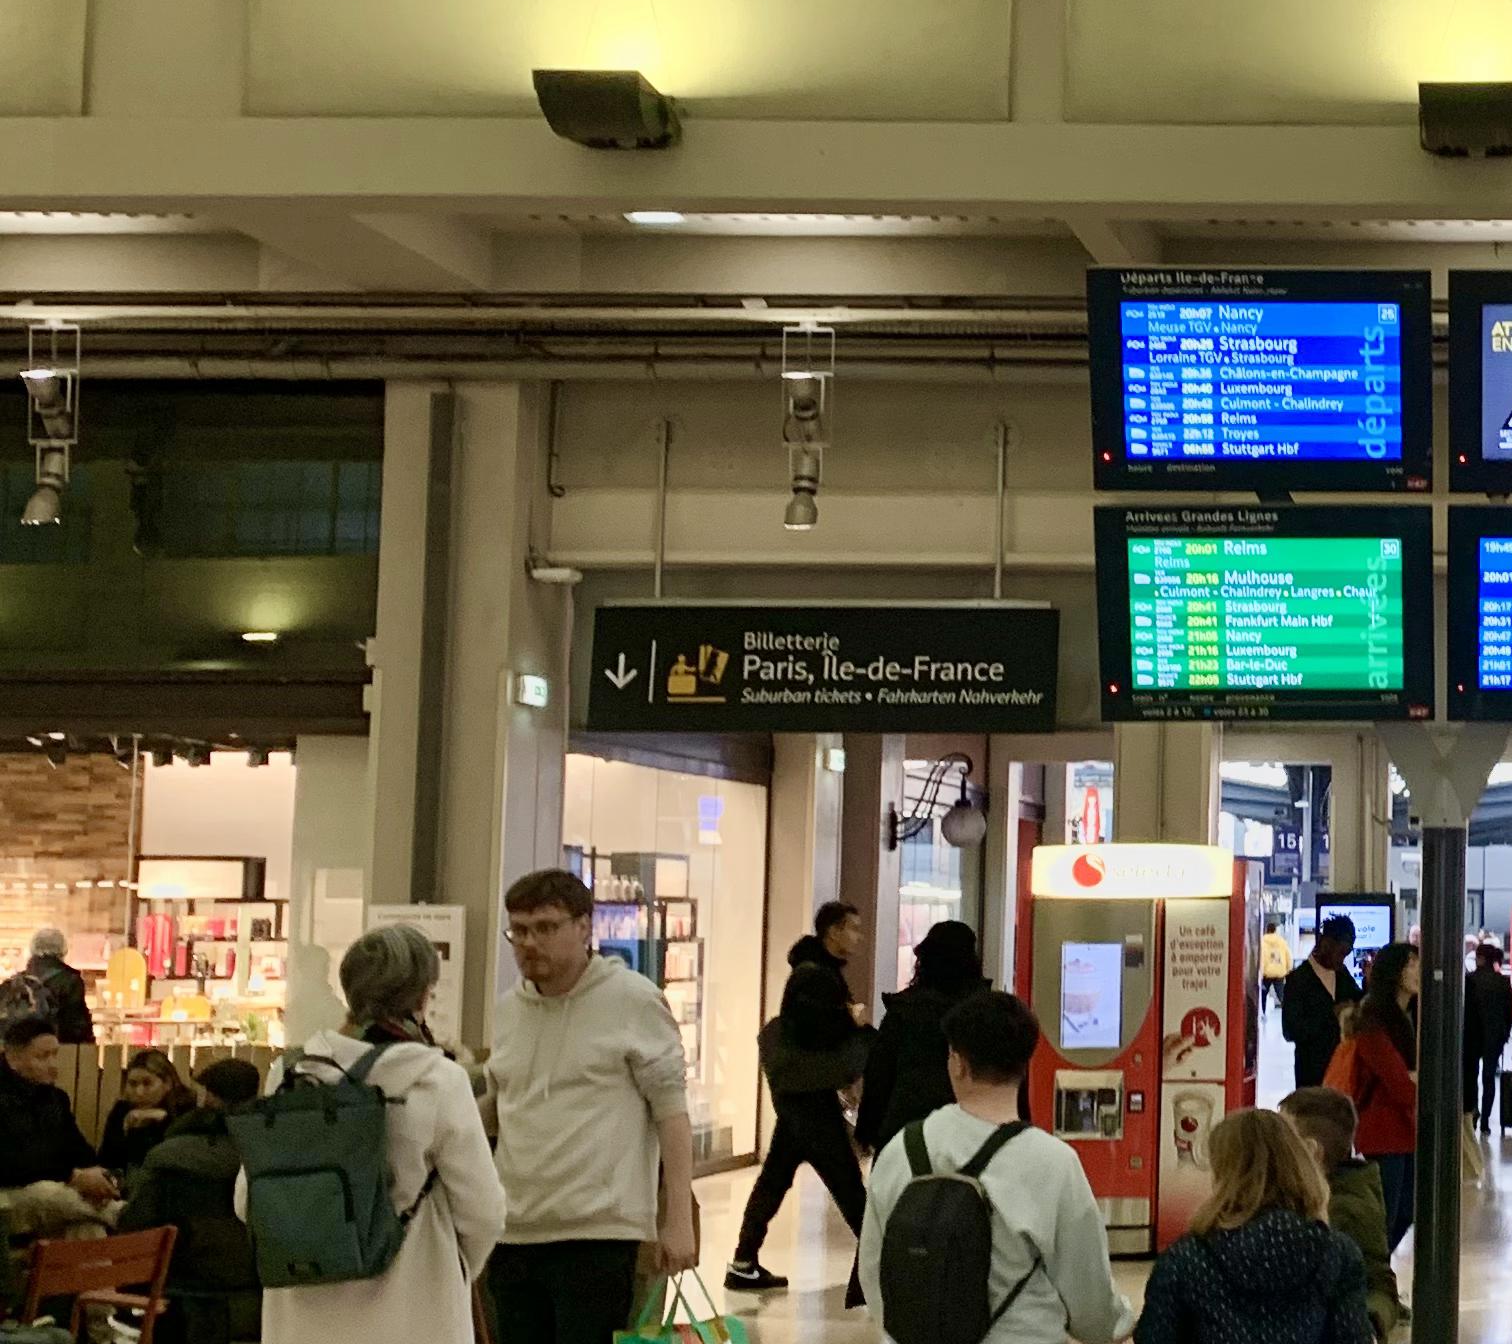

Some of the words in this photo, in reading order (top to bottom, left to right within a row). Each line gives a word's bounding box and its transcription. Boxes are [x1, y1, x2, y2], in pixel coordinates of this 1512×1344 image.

[1219, 306, 1263, 320] Nancy
[1148, 322, 1187, 332] Meuse
[1189, 322, 1211, 332] TGV
[1221, 322, 1257, 335] Nancy
[1219, 337, 1298, 354] Strasbourg
[1149, 352, 1198, 364] Lorraine
[1199, 353, 1222, 364] TGV
[1231, 353, 1294, 366] Strasbourg
[1220, 367, 1358, 382] Châlons-en-Champagne
[1221, 383, 1292, 396] Luxembourg
[1358, 326, 1393, 459] départs
[1221, 398, 1271, 409] Culmont
[1282, 397, 1343, 412] Chalindrey
[1221, 413, 1257, 425] Reims
[1222, 427, 1259, 440] Troyes
[1223, 442, 1274, 457] Stuttgart
[1277, 441, 1299, 455] Hbf
[1181, 511, 1234, 523] Grandes
[1237, 511, 1279, 524] Lignes
[1224, 541, 1267, 555] Reims
[1383, 543, 1397, 555] 30
[1155, 556, 1189, 569] Reims
[1224, 570, 1294, 585] Mulhouse
[1160, 587, 1210, 598] Culmont
[1220, 587, 1282, 600] Chalindrey
[1291, 587, 1334, 601] Langres
[1225, 600, 1287, 614] Strasbourg
[1225, 614, 1278, 627] Frankfurt
[1281, 615, 1308, 627] Main
[1311, 613, 1334, 627] Hbf
[743, 632, 840, 652] Billetterie
[1226, 630, 1262, 643] Nancy
[1226, 644, 1297, 658] Luxembourg
[742, 656, 815, 686] Paris,
[824, 651, 1005, 682] Île-de-France
[1226, 659, 1288, 671] Bar-le-Duc
[1227, 674, 1279, 688] Stuttgart
[1281, 673, 1303, 685] Hbf
[741, 687, 811, 704] Suburban
[814, 687, 862, 705] tickets
[877, 687, 957, 705] Fahrkarten
[959, 687, 1043, 706] Nahverkehr
[1179, 926, 1192, 937] Un
[1199, 925, 1216, 937] café
[1170, 938, 1224, 952] d'exception
[1179, 955, 1222, 966] emporter
[1172, 970, 1194, 981] pour
[1196, 969, 1221, 977] votre
[1182, 981, 1208, 992] trajet
